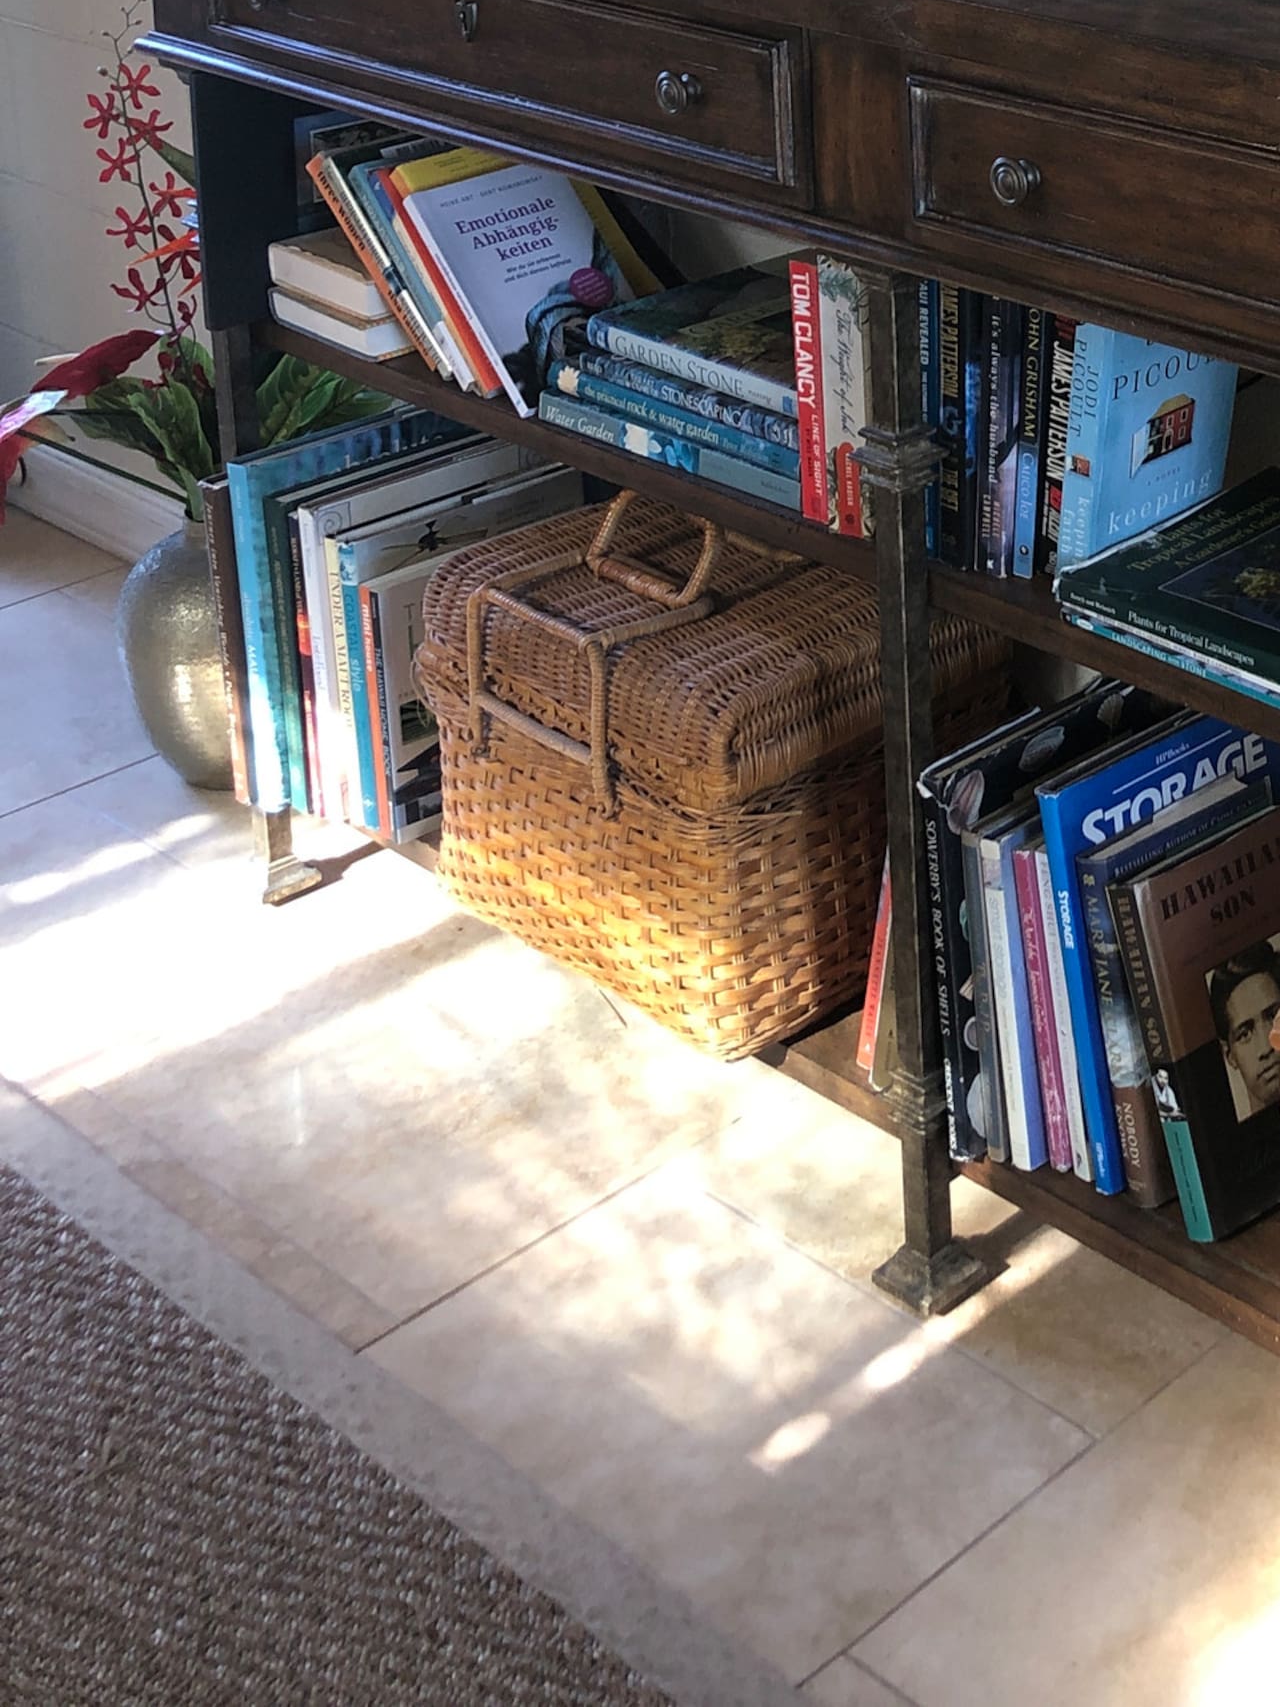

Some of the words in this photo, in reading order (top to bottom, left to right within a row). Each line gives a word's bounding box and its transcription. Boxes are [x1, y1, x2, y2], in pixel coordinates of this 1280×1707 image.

[454, 197, 557, 235] Emotionale
[472, 216, 560, 250] Abhängig-
[495, 237, 553, 261] keiten
[790, 272, 809, 317] TOM
[918, 280, 928, 303] AUI
[919, 307, 929, 365] REVEALED
[1027, 307, 1040, 350] OHN
[615, 335, 682, 375] GARDEN
[687, 361, 744, 396] STONE
[794, 321, 816, 409] CLANCY
[941, 324, 959, 398] PATTERSON
[987, 342, 1000, 390] always
[1050, 340, 1070, 395] JAMES
[661, 384, 746, 426] STONESCAPING
[989, 395, 999, 420] the
[1023, 356, 1037, 436] GRISHAM
[1070, 340, 1088, 437] PICOULT
[1083, 366, 1099, 419] JODI
[545, 406, 575, 427] Water
[577, 417, 615, 442] Garden
[626, 395, 649, 417] rock
[685, 421, 719, 444] garden
[811, 414, 819, 441] LINE
[1045, 395, 1068, 482] PATTERSON
[813, 444, 820, 457] OF
[988, 423, 998, 483] husband
[814, 460, 822, 496] SIGHT
[1107, 469, 1213, 535] keeping
[328, 570, 344, 626] UNDER
[358, 603, 372, 635] mini
[333, 626, 345, 638] A
[1128, 610, 1154, 630] Plants
[1154, 620, 1169, 636] for
[1169, 624, 1204, 649] Tropical
[1204, 634, 1255, 667] Landscapes
[335, 643, 349, 686] MAUI
[1081, 732, 1268, 845] STORAGE
[924, 818, 941, 902] SOWERBY'S
[931, 908, 944, 949] BOOK
[1056, 889, 1076, 949] STORAGE
[1084, 894, 1107, 956] MARY
[1209, 886, 1256, 924] SON
[934, 955, 946, 978] OF
[1094, 957, 1115, 1008] JANE
[937, 983, 950, 1036] SHELLS
[1142, 1015, 1165, 1058] SON
[1115, 1100, 1148, 1169] NOBODY
